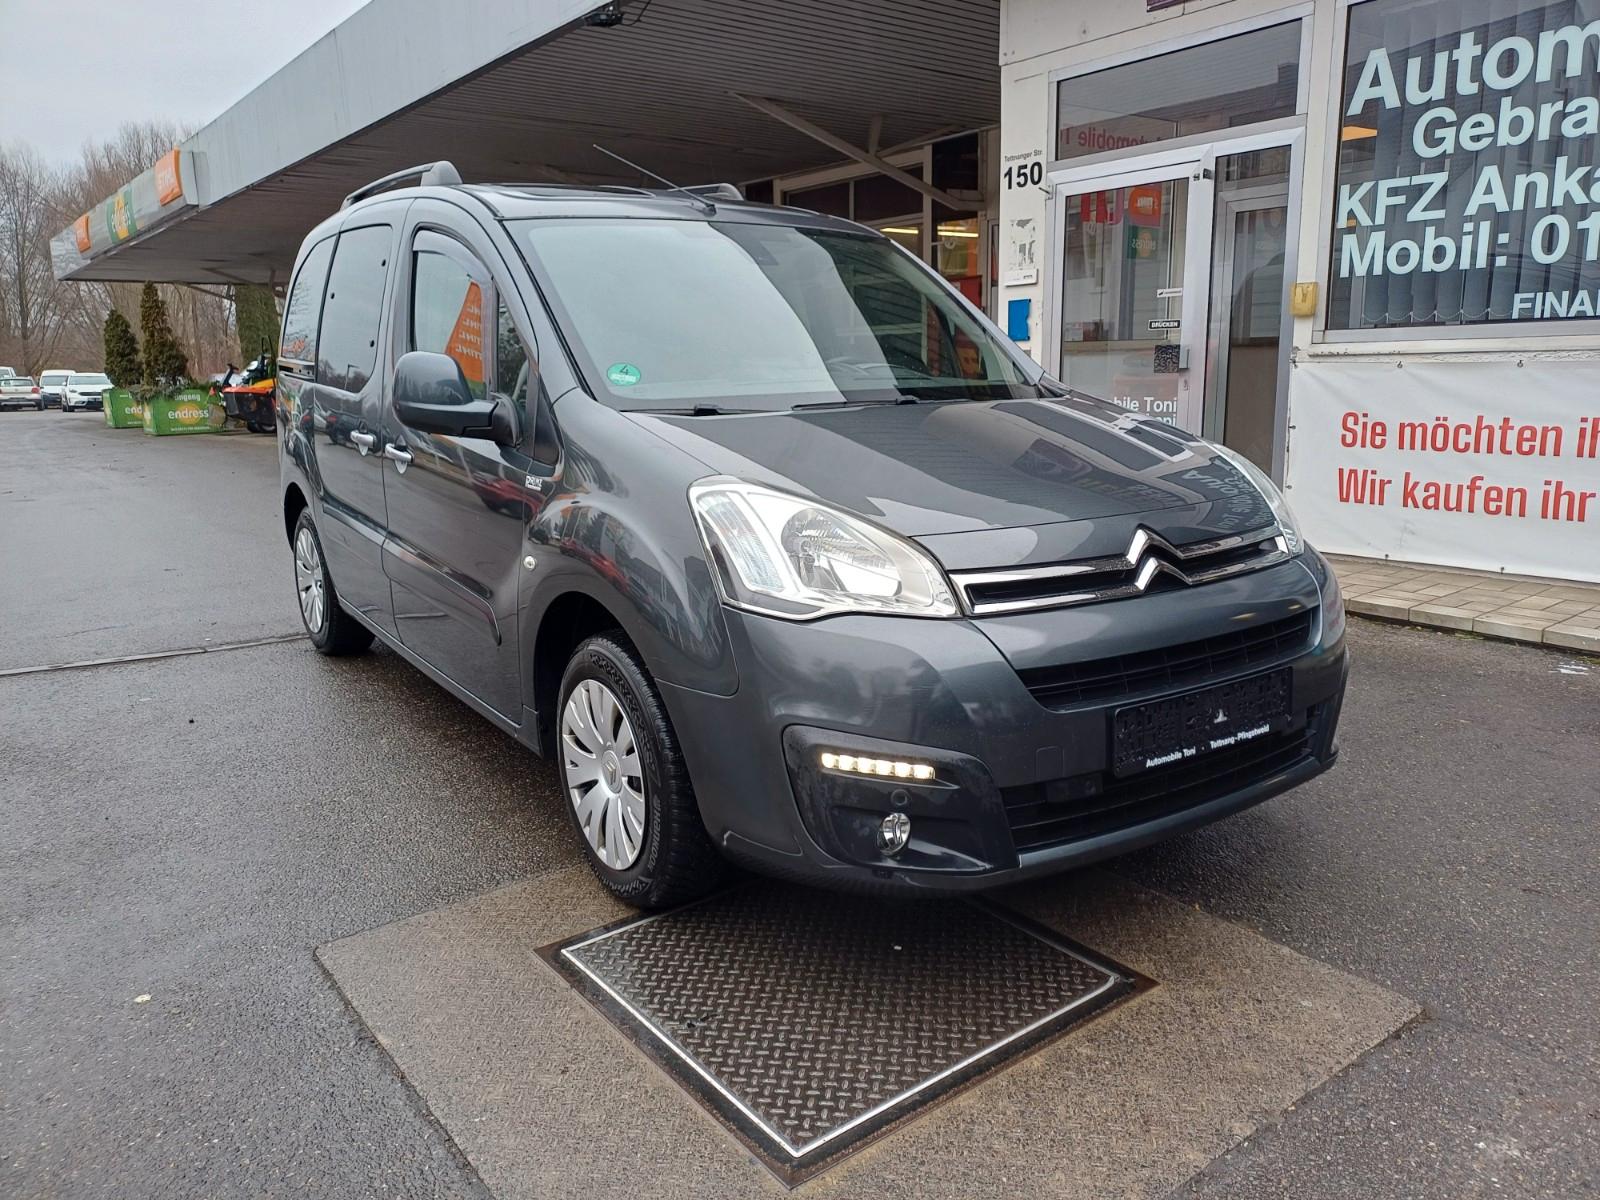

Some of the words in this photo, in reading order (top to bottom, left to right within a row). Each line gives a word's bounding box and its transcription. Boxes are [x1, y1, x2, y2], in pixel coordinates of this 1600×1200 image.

[1346, 20, 1600, 116] Autom
[1412, 96, 1600, 159] Gebra
[1004, 162, 1043, 190] 150
[1336, 171, 1448, 229] KFZ
[1339, 221, 1511, 279] Mobil:
[1511, 289, 1600, 319] FINA
[619, 364, 629, 376] 4
[168, 407, 209, 419] endress
[1143, 396, 1177, 413] Toni
[1340, 411, 1387, 449] Sie
[1398, 415, 1563, 457] möchten
[1338, 467, 1392, 506] Wir
[1402, 472, 1528, 518] kaufen
[1540, 480, 1597, 522] ihr
[1146, 751, 1182, 768] Automobile
[1183, 747, 1196, 758] Toni
